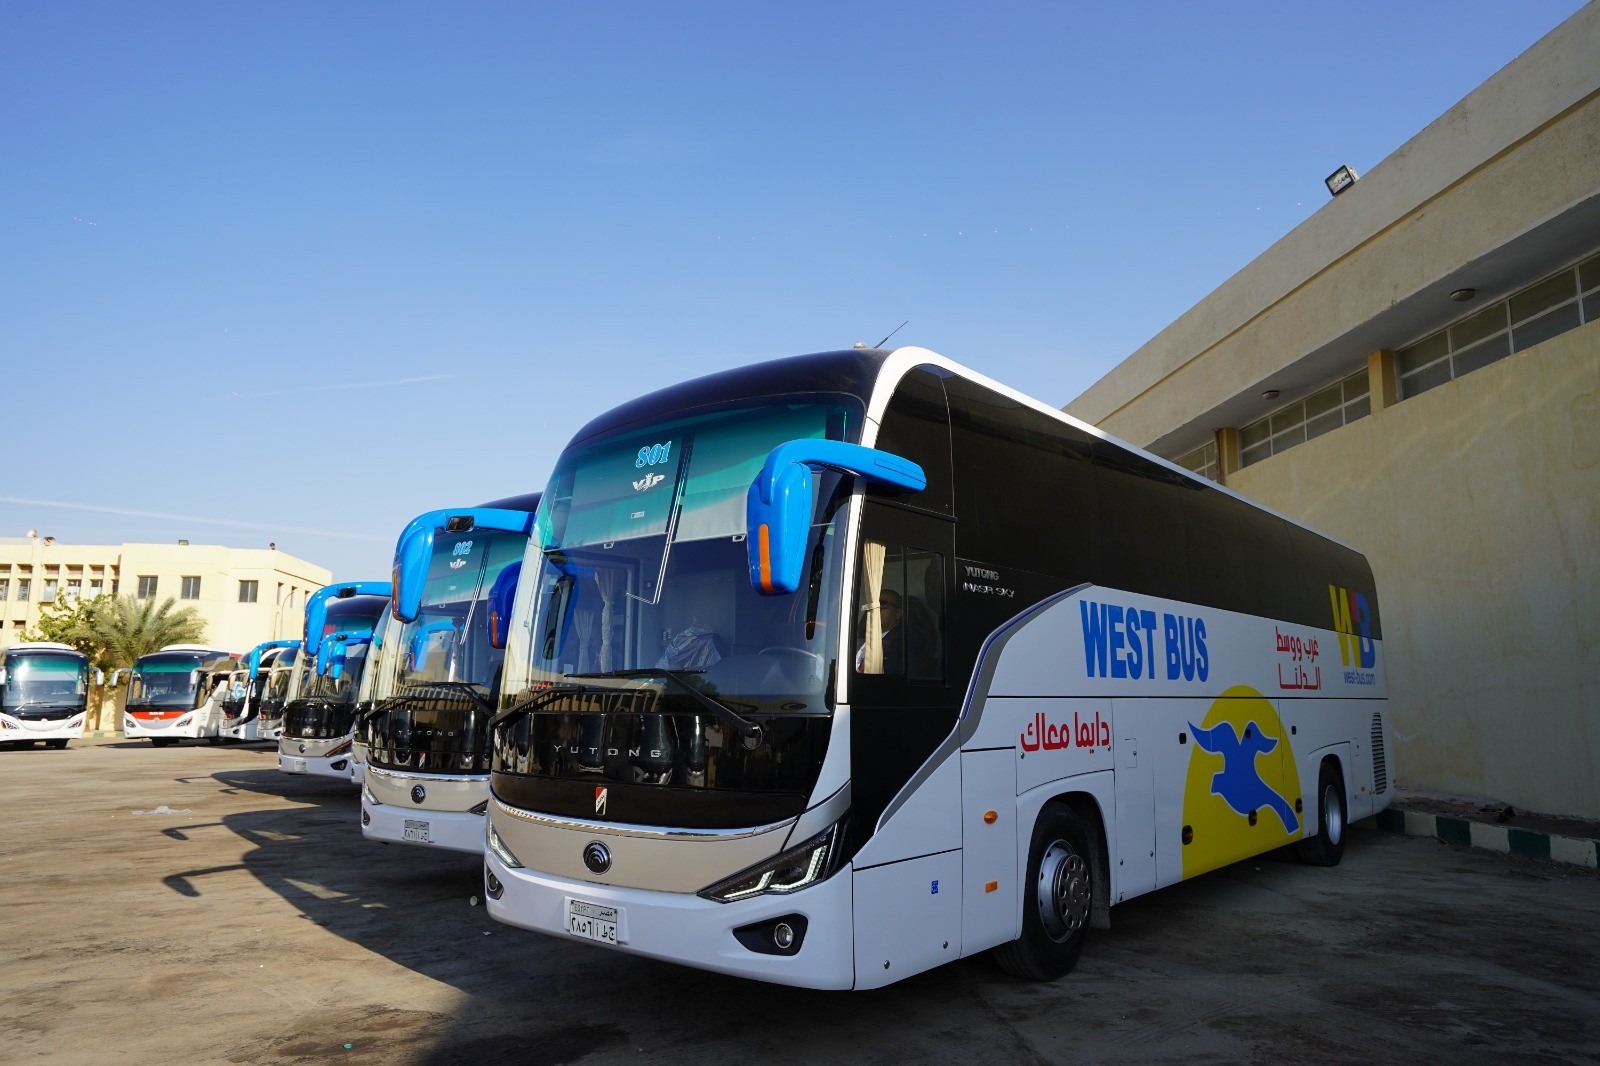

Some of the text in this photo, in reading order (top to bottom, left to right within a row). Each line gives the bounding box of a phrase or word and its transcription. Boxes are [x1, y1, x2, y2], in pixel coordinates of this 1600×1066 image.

[635, 441, 672, 468] 801
[632, 473, 665, 491] VIP
[963, 565, 1000, 581] YUTONG
[1080, 599, 1209, 683] WEST BUS
[1275, 625, 1319, 663] غرب ووسط
[1343, 669, 1376, 686] west-bus.com
[398, 729, 454, 737] YUTONG
[1020, 711, 1110, 754] دايما معاك
[553, 744, 662, 758] YUTONG
[574, 903, 590, 914] EGYPT
[571, 916, 592, 937] ٢٨٥٦
